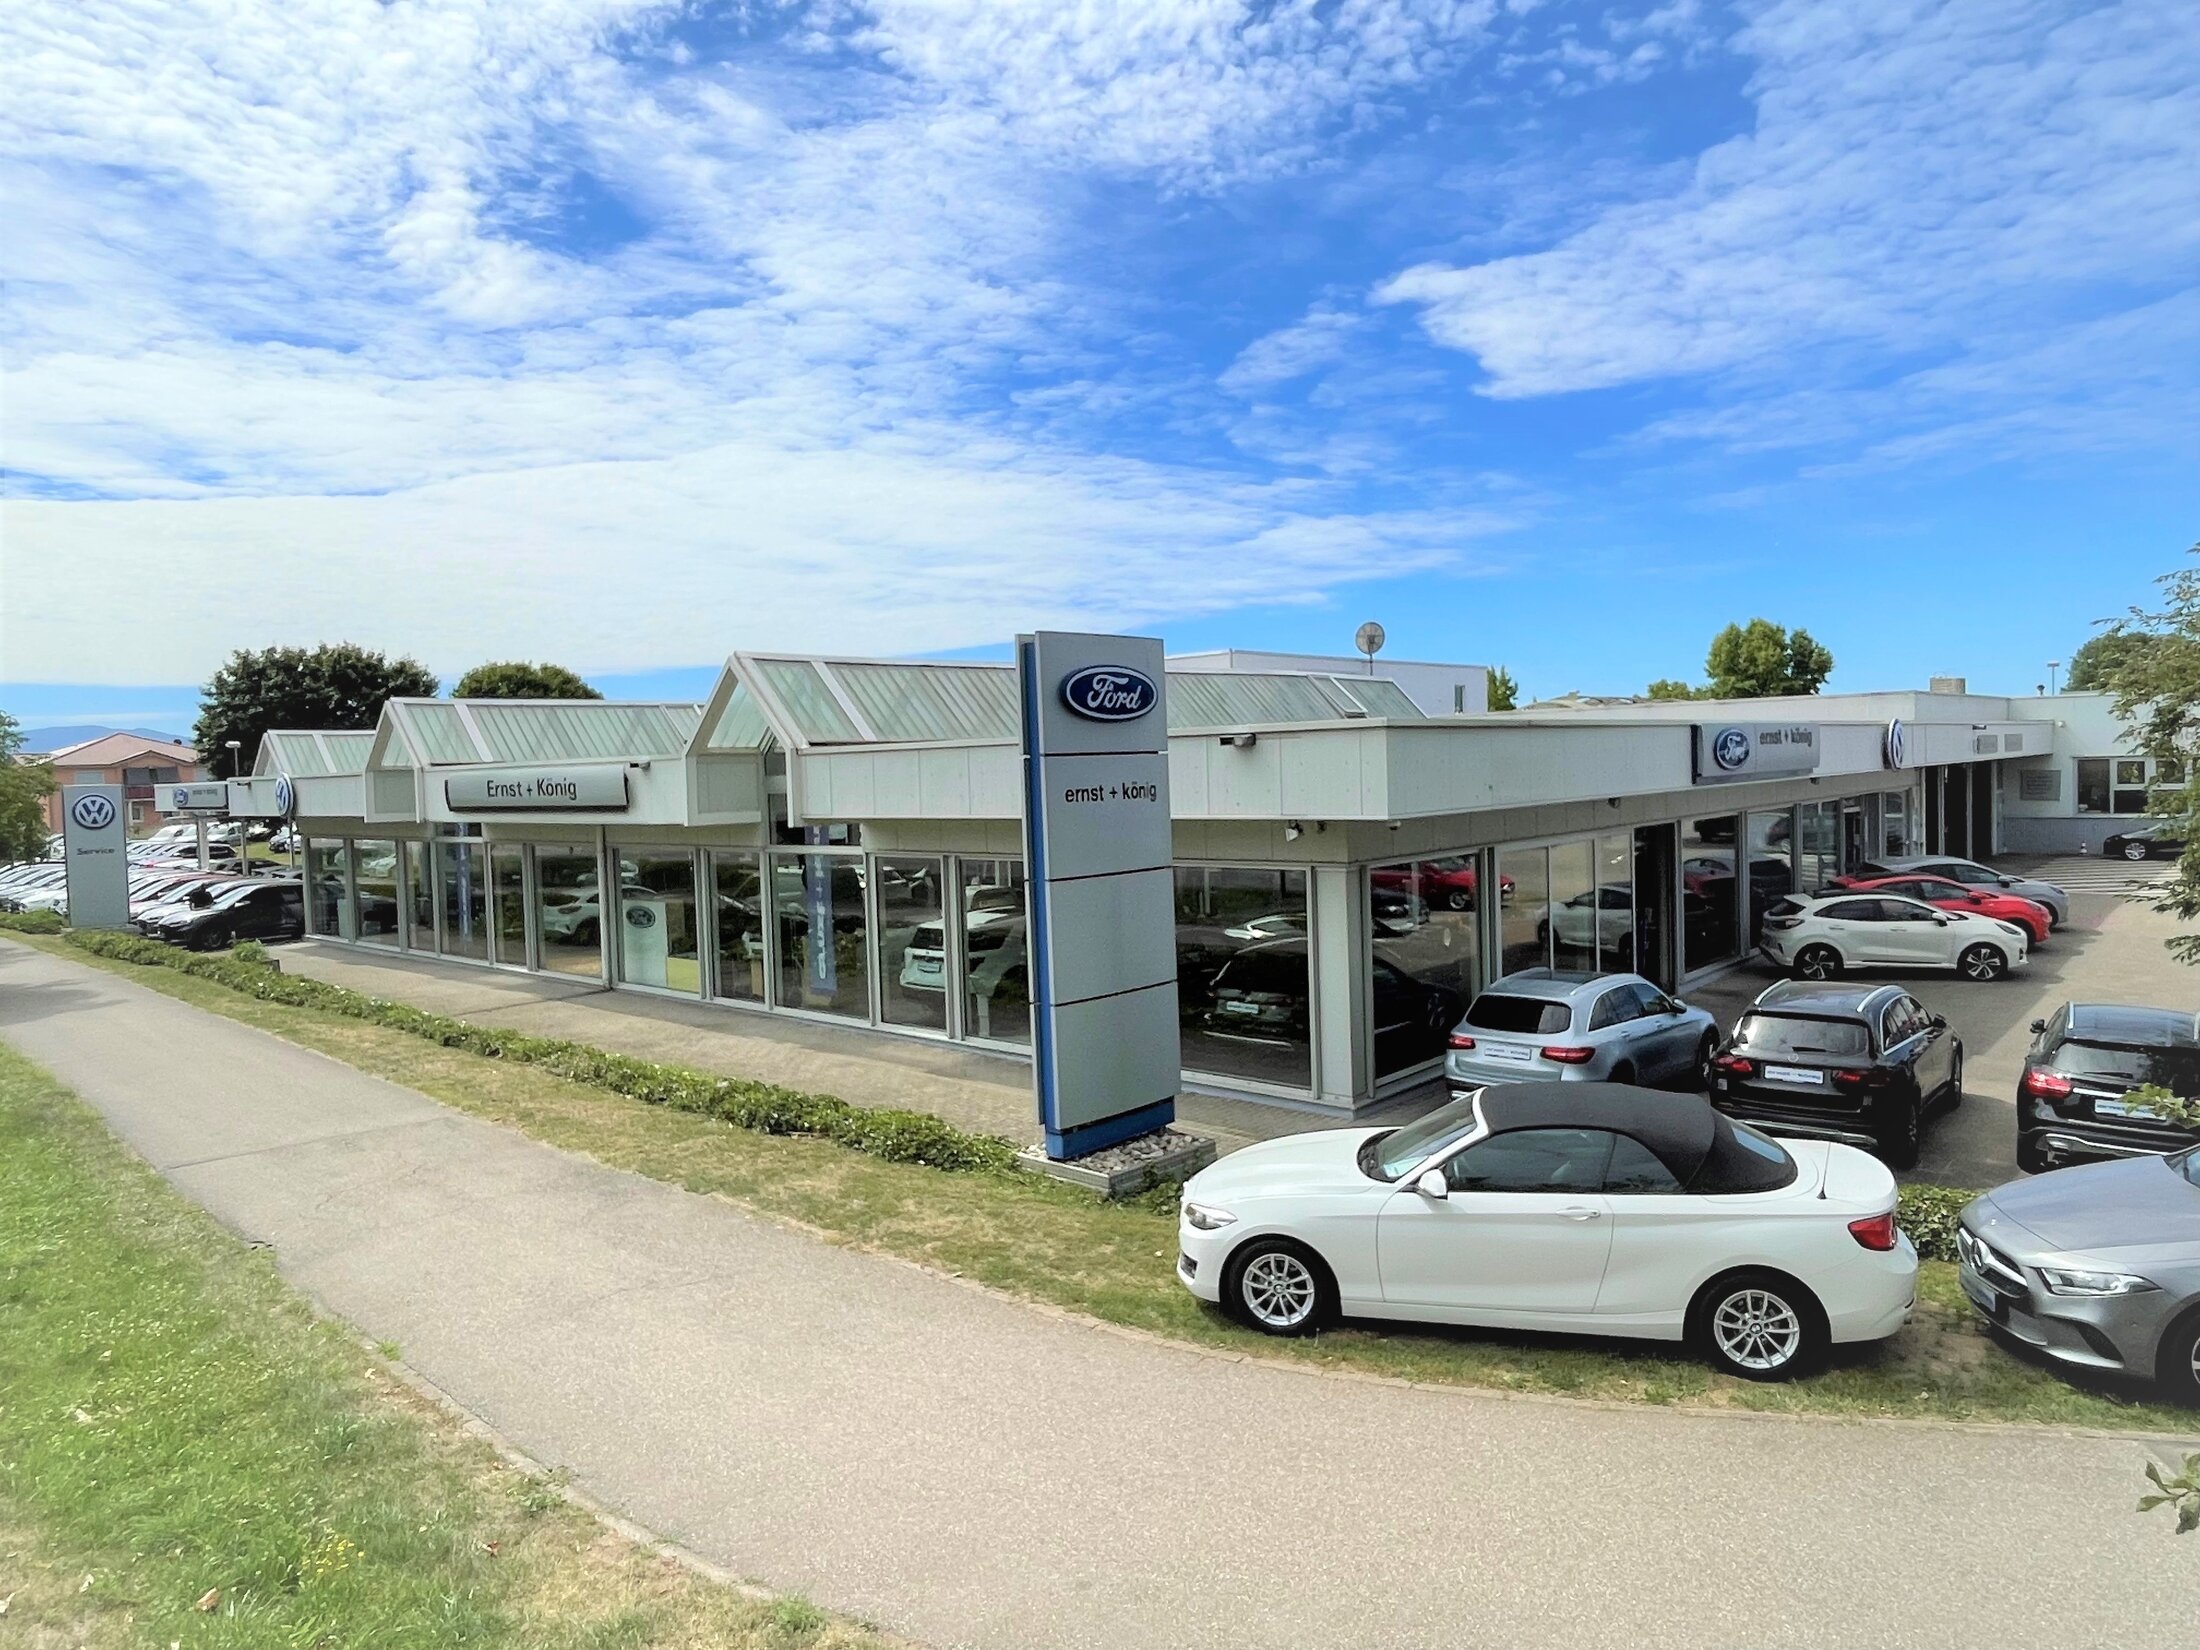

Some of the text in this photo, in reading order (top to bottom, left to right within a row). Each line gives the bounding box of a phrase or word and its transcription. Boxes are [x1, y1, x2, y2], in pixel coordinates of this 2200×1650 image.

[1086, 674, 1142, 710] Ford
[1759, 729, 1782, 745] ernst
[487, 777, 578, 801] Ernst + König
[1065, 781, 1157, 803] ernst + könig
